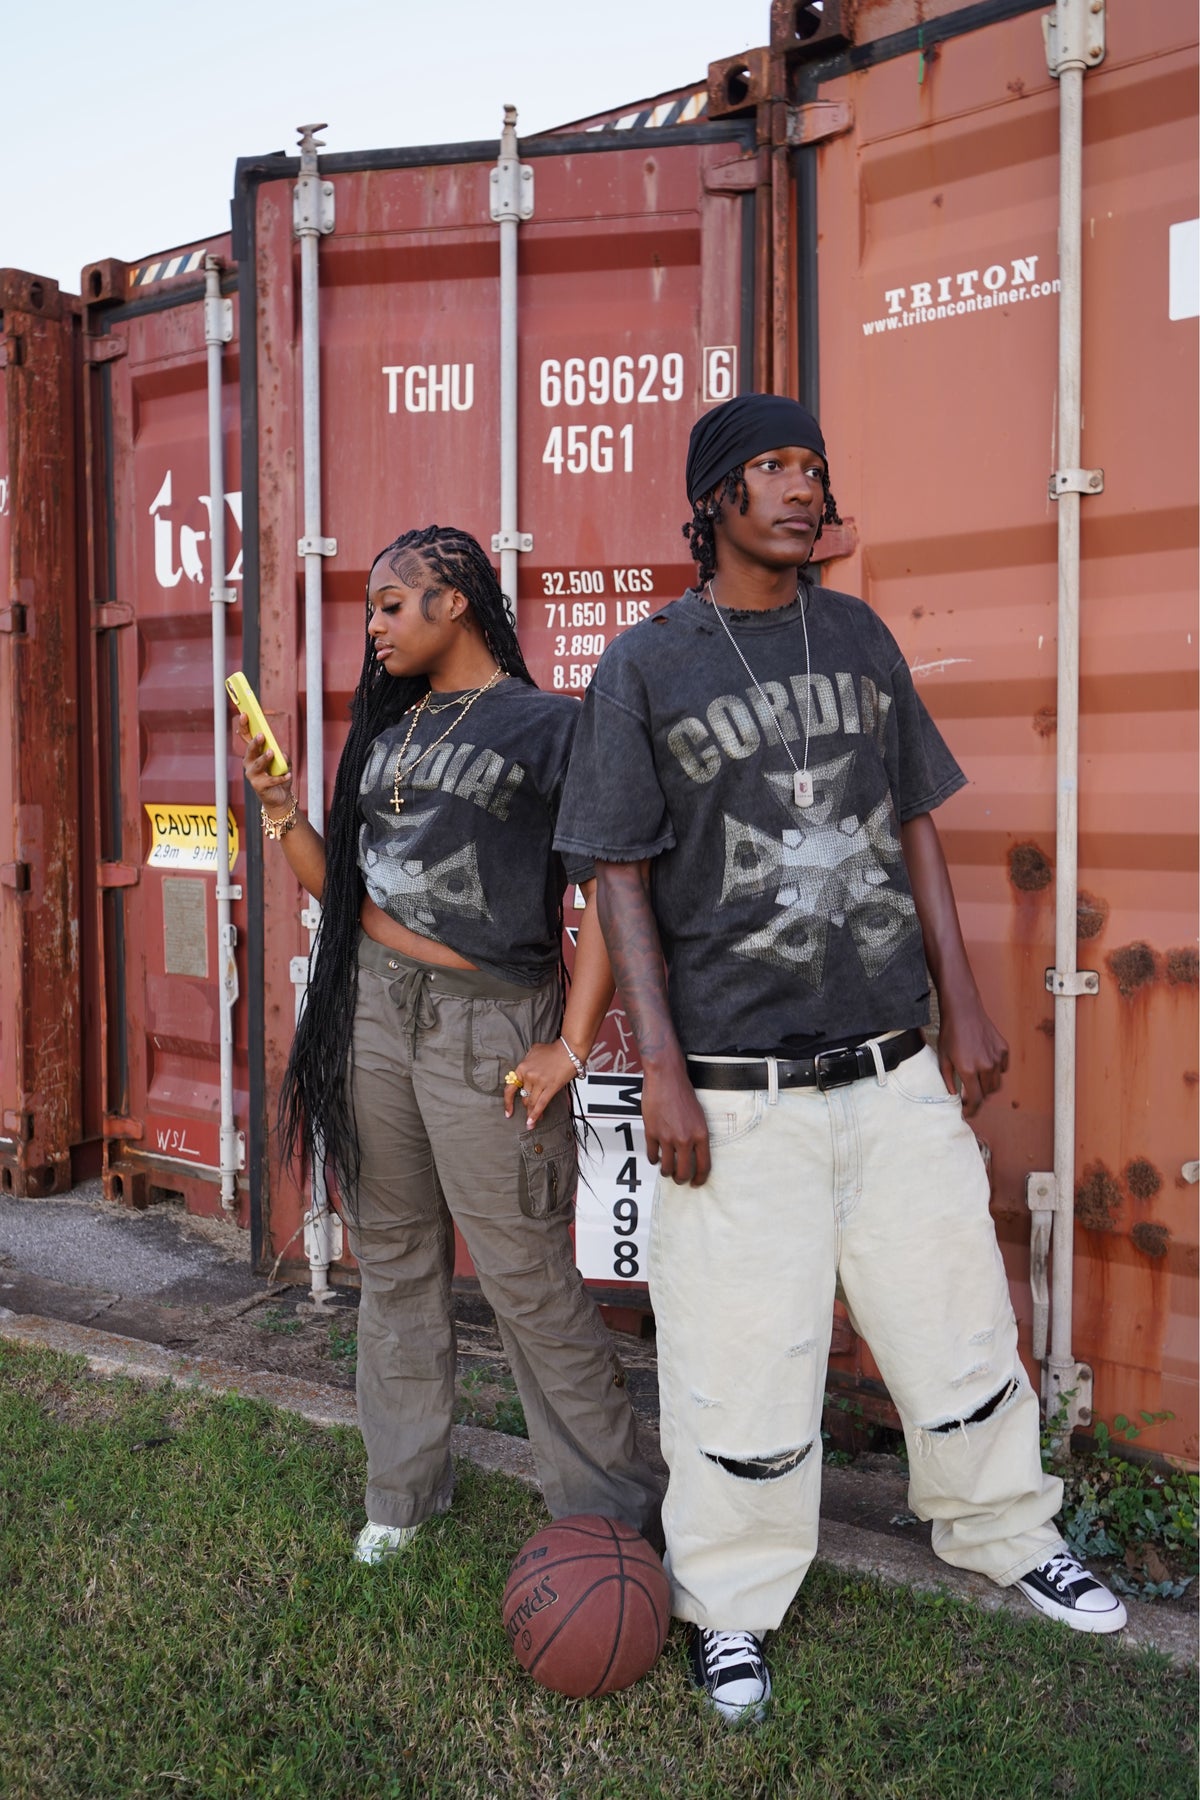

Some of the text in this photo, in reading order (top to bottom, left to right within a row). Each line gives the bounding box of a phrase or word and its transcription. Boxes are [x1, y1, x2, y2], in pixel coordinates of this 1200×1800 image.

[885, 255, 1039, 314] TRITON
[382, 349, 731, 414] TGHU 669629 6
[542, 423, 634, 475] 45G1
[541, 568, 654, 595] 32.500 KGS
[544, 600, 651, 628] 71.650 LBS
[553, 634, 606, 657] 3.890
[552, 663, 598, 689] 8.58
